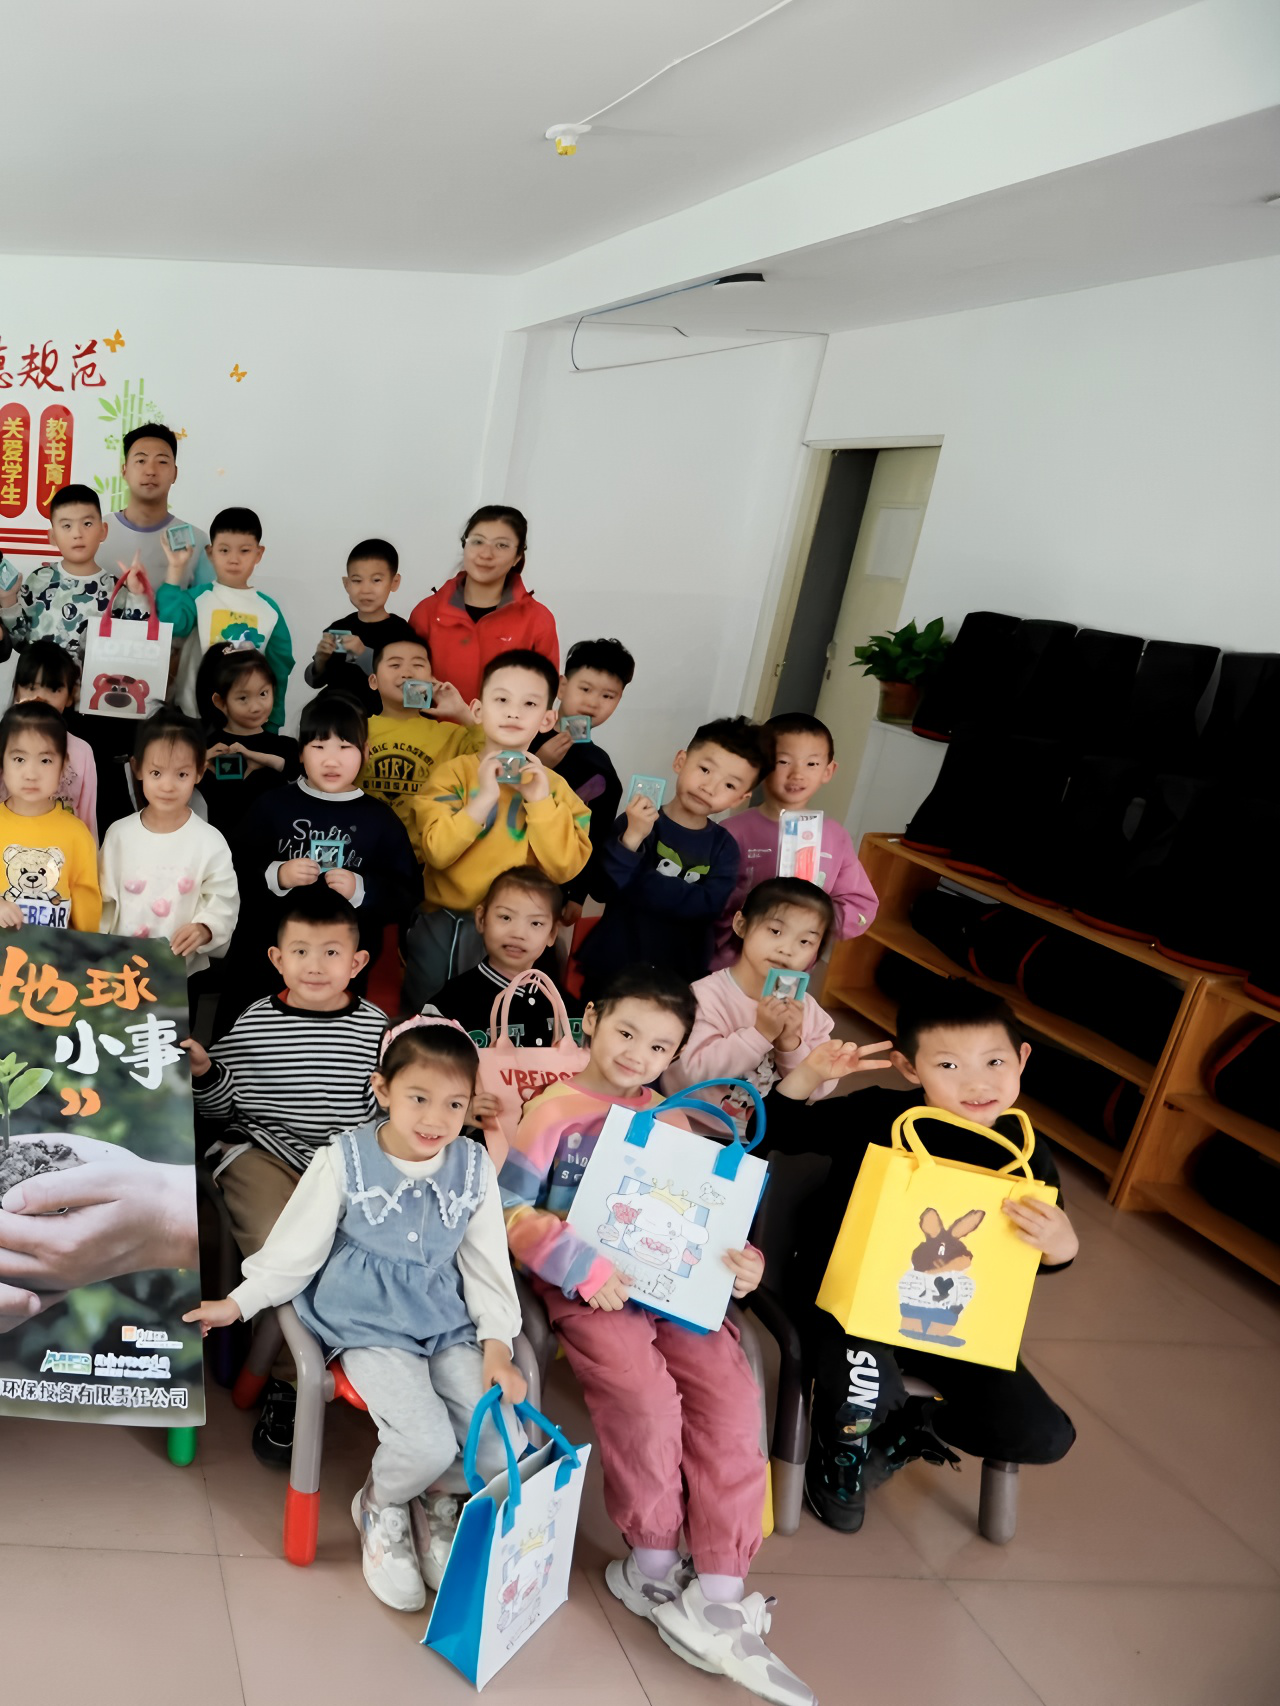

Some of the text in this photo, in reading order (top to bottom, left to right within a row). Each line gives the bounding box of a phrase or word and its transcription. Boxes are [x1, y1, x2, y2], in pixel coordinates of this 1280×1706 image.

[1, 417, 24, 505] 关爱学生
[55, 1013, 186, 1090] 小事
